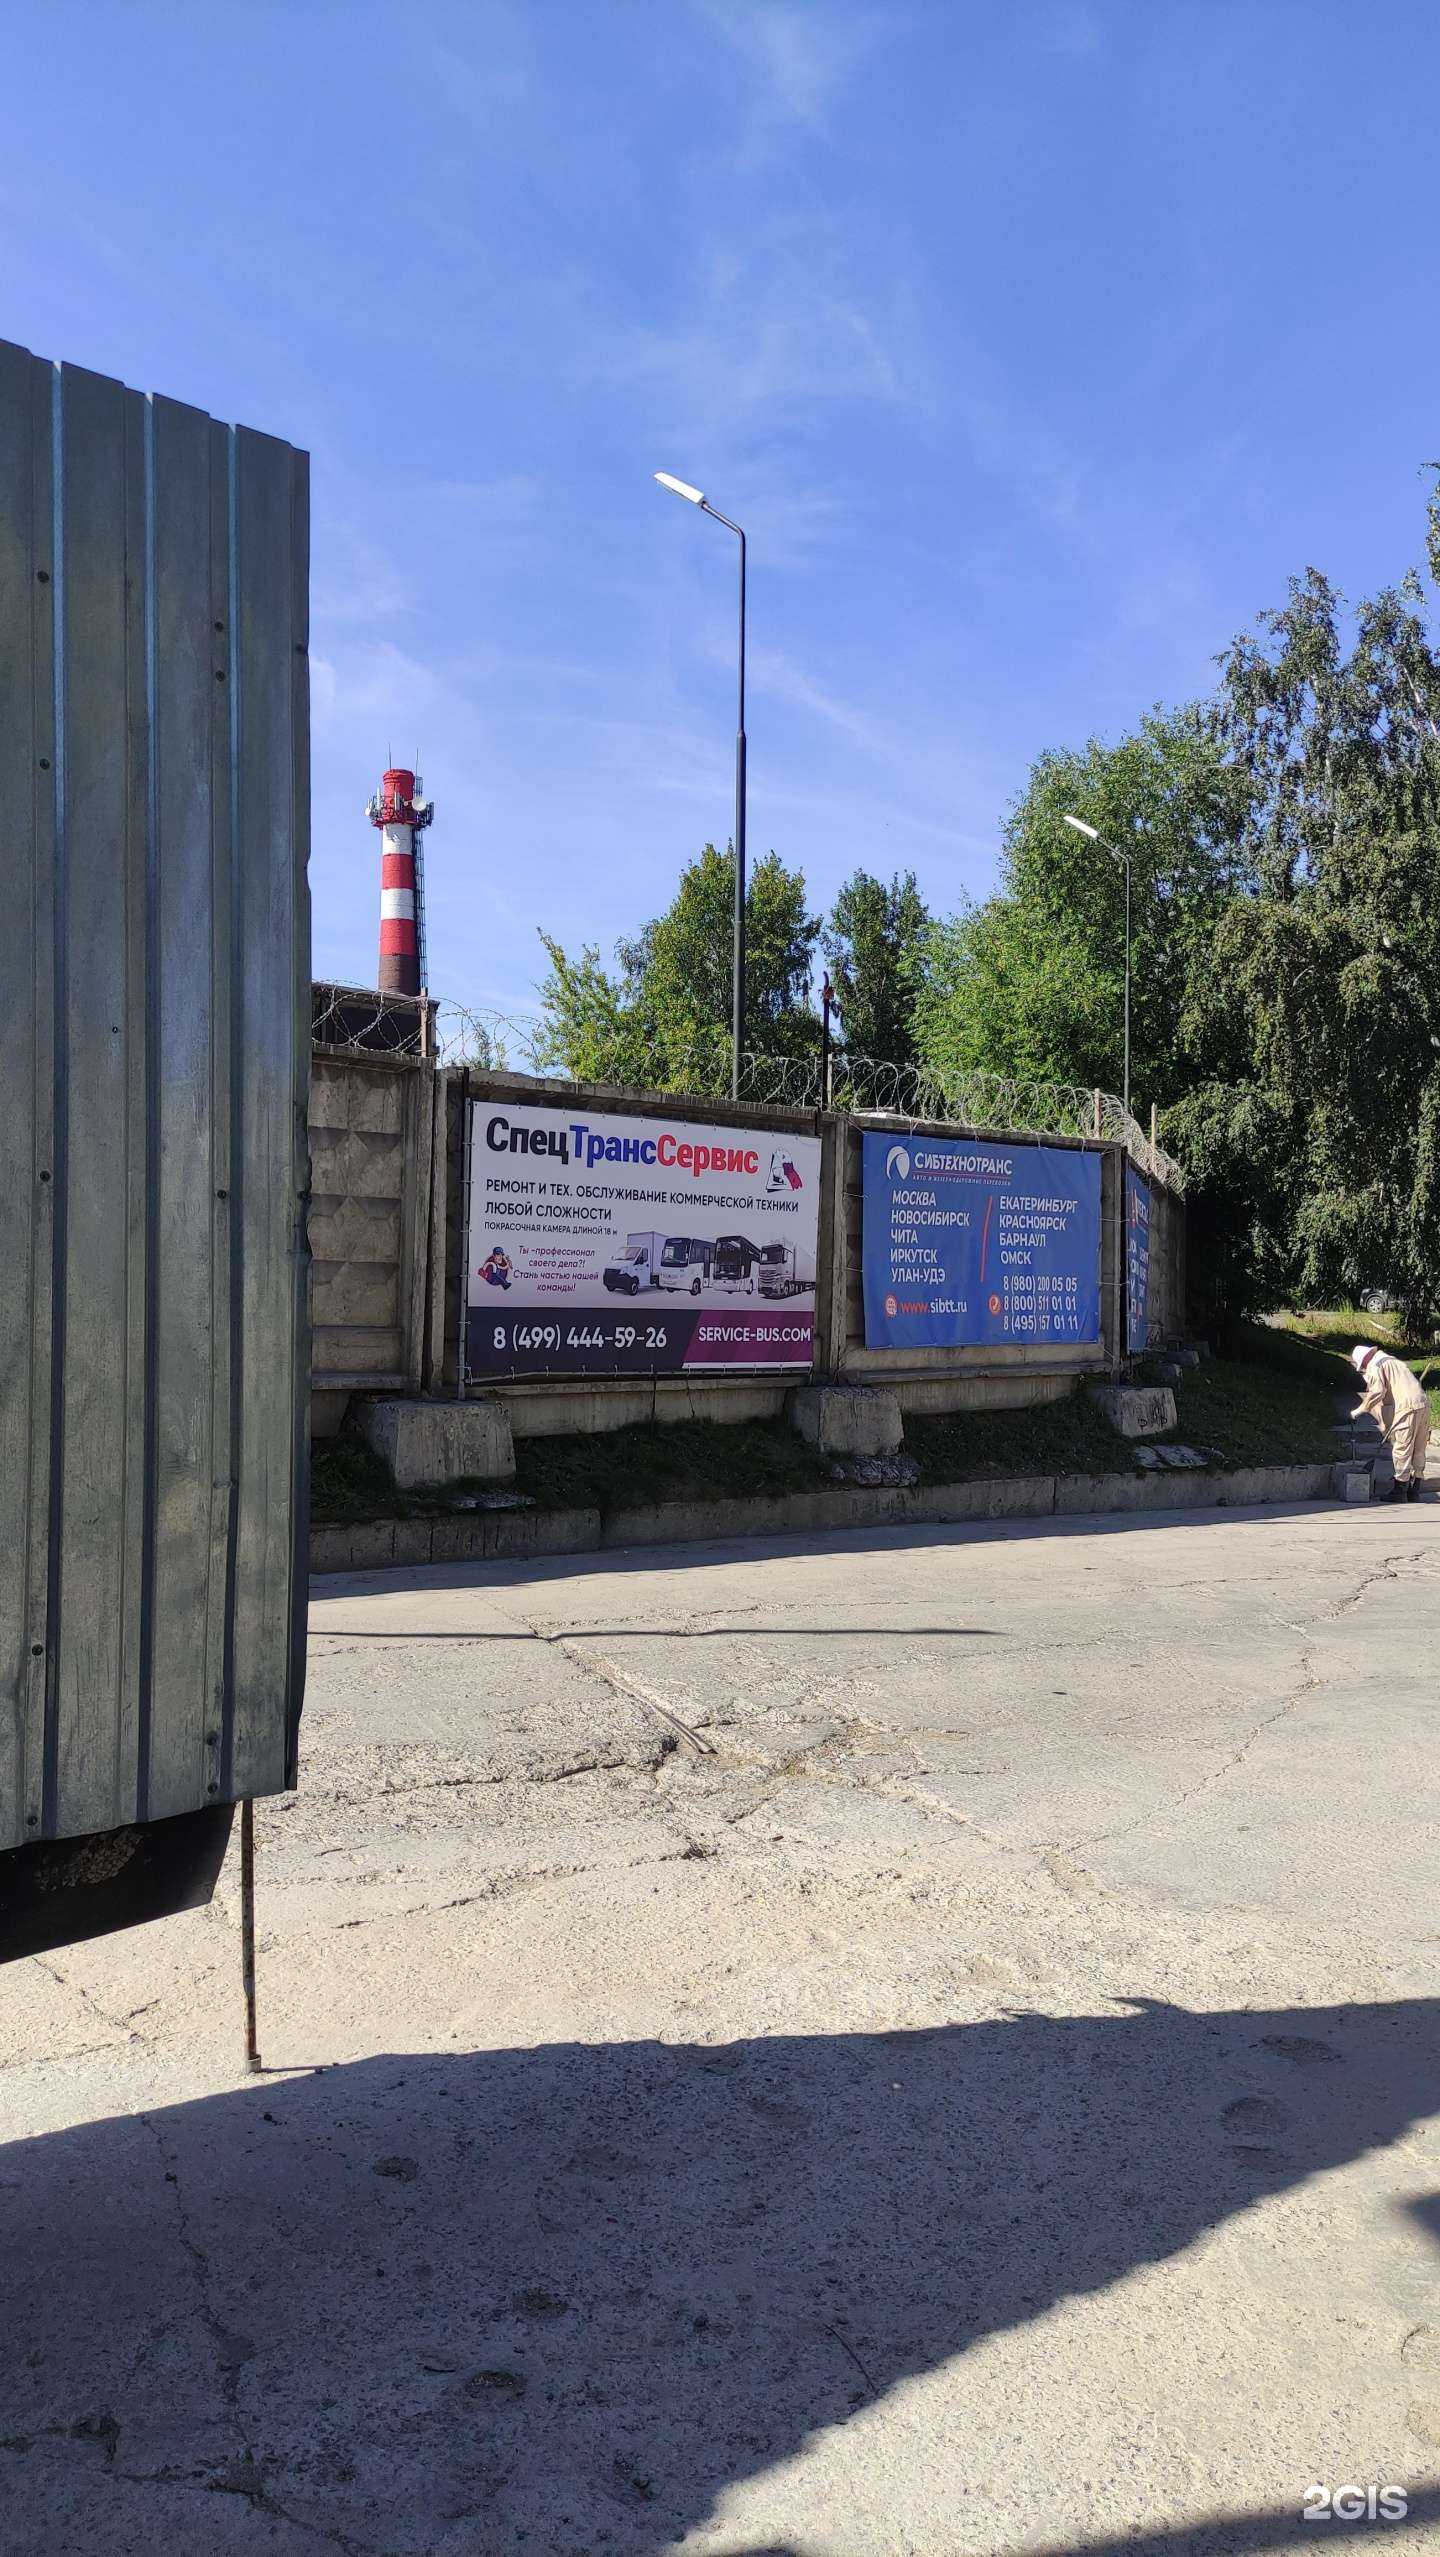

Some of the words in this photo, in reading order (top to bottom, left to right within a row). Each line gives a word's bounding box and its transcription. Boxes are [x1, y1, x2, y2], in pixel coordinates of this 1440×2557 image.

[486, 1116, 759, 1177] СпецТрансСервис
[914, 1152, 1013, 1175] СИБТЕХНОТРАНС
[486, 1178, 535, 1195] РЕМОНТ
[538, 1183, 547, 1195] И
[550, 1183, 573, 1198] ТЕХ.
[576, 1185, 667, 1203] ОБСЛУЖИВАНИЕ
[670, 1192, 754, 1210] КОММЕРЧЕСКОЙ
[756, 1198, 799, 1213] ТЕХНИКИ
[892, 1190, 937, 1207] МОСКВА
[1000, 1195, 1078, 1213] ЕКАТЕРИНБУРГ
[484, 1201, 533, 1216] ЛЮБОЙ
[536, 1205, 612, 1220] СЛОЖНОСТИ
[891, 1209, 970, 1227] НОВОСИБИРСК
[484, 1221, 541, 1232] ПОКРАСОЧНАЯ
[542, 1224, 571, 1234] КАМЕРА
[572, 1225, 602, 1235] ДЛИНОЙ
[999, 1214, 1067, 1231] КРАСНОЯРСК
[890, 1229, 918, 1244] ЧИТА
[999, 1232, 1046, 1247] БАРНАУЛ
[890, 1248, 938, 1264] ИРКУТСК
[1000, 1251, 1032, 1265] ОМСК
[513, 1269, 538, 1279] Стань
[540, 1272, 571, 1280] частью
[572, 1271, 599, 1280] нашей
[891, 1268, 946, 1285] УЛАН-УДЭ
[536, 1283, 576, 1293] команды!
[1003, 1275, 1009, 1291] 8
[1011, 1275, 1036, 1295] (980)
[1052, 1276, 1063, 1292] 05
[1065, 1276, 1078, 1292] 05
[901, 1298, 967, 1314] www.sibtt.ru
[1004, 1295, 1009, 1311] 8
[1011, 1295, 1037, 1314] (800)
[1052, 1295, 1063, 1311] 01
[1065, 1295, 1076, 1311] 01
[1003, 1315, 1009, 1331] 8
[1011, 1315, 1037, 1335] (495)
[1053, 1314, 1065, 1330] 01
[1067, 1315, 1078, 1330] 11
[493, 1326, 506, 1350] 8
[512, 1324, 561, 1351] (499)
[566, 1326, 667, 1348] 444-59-26
[698, 1326, 811, 1342] SERVICE-BUS.COM
